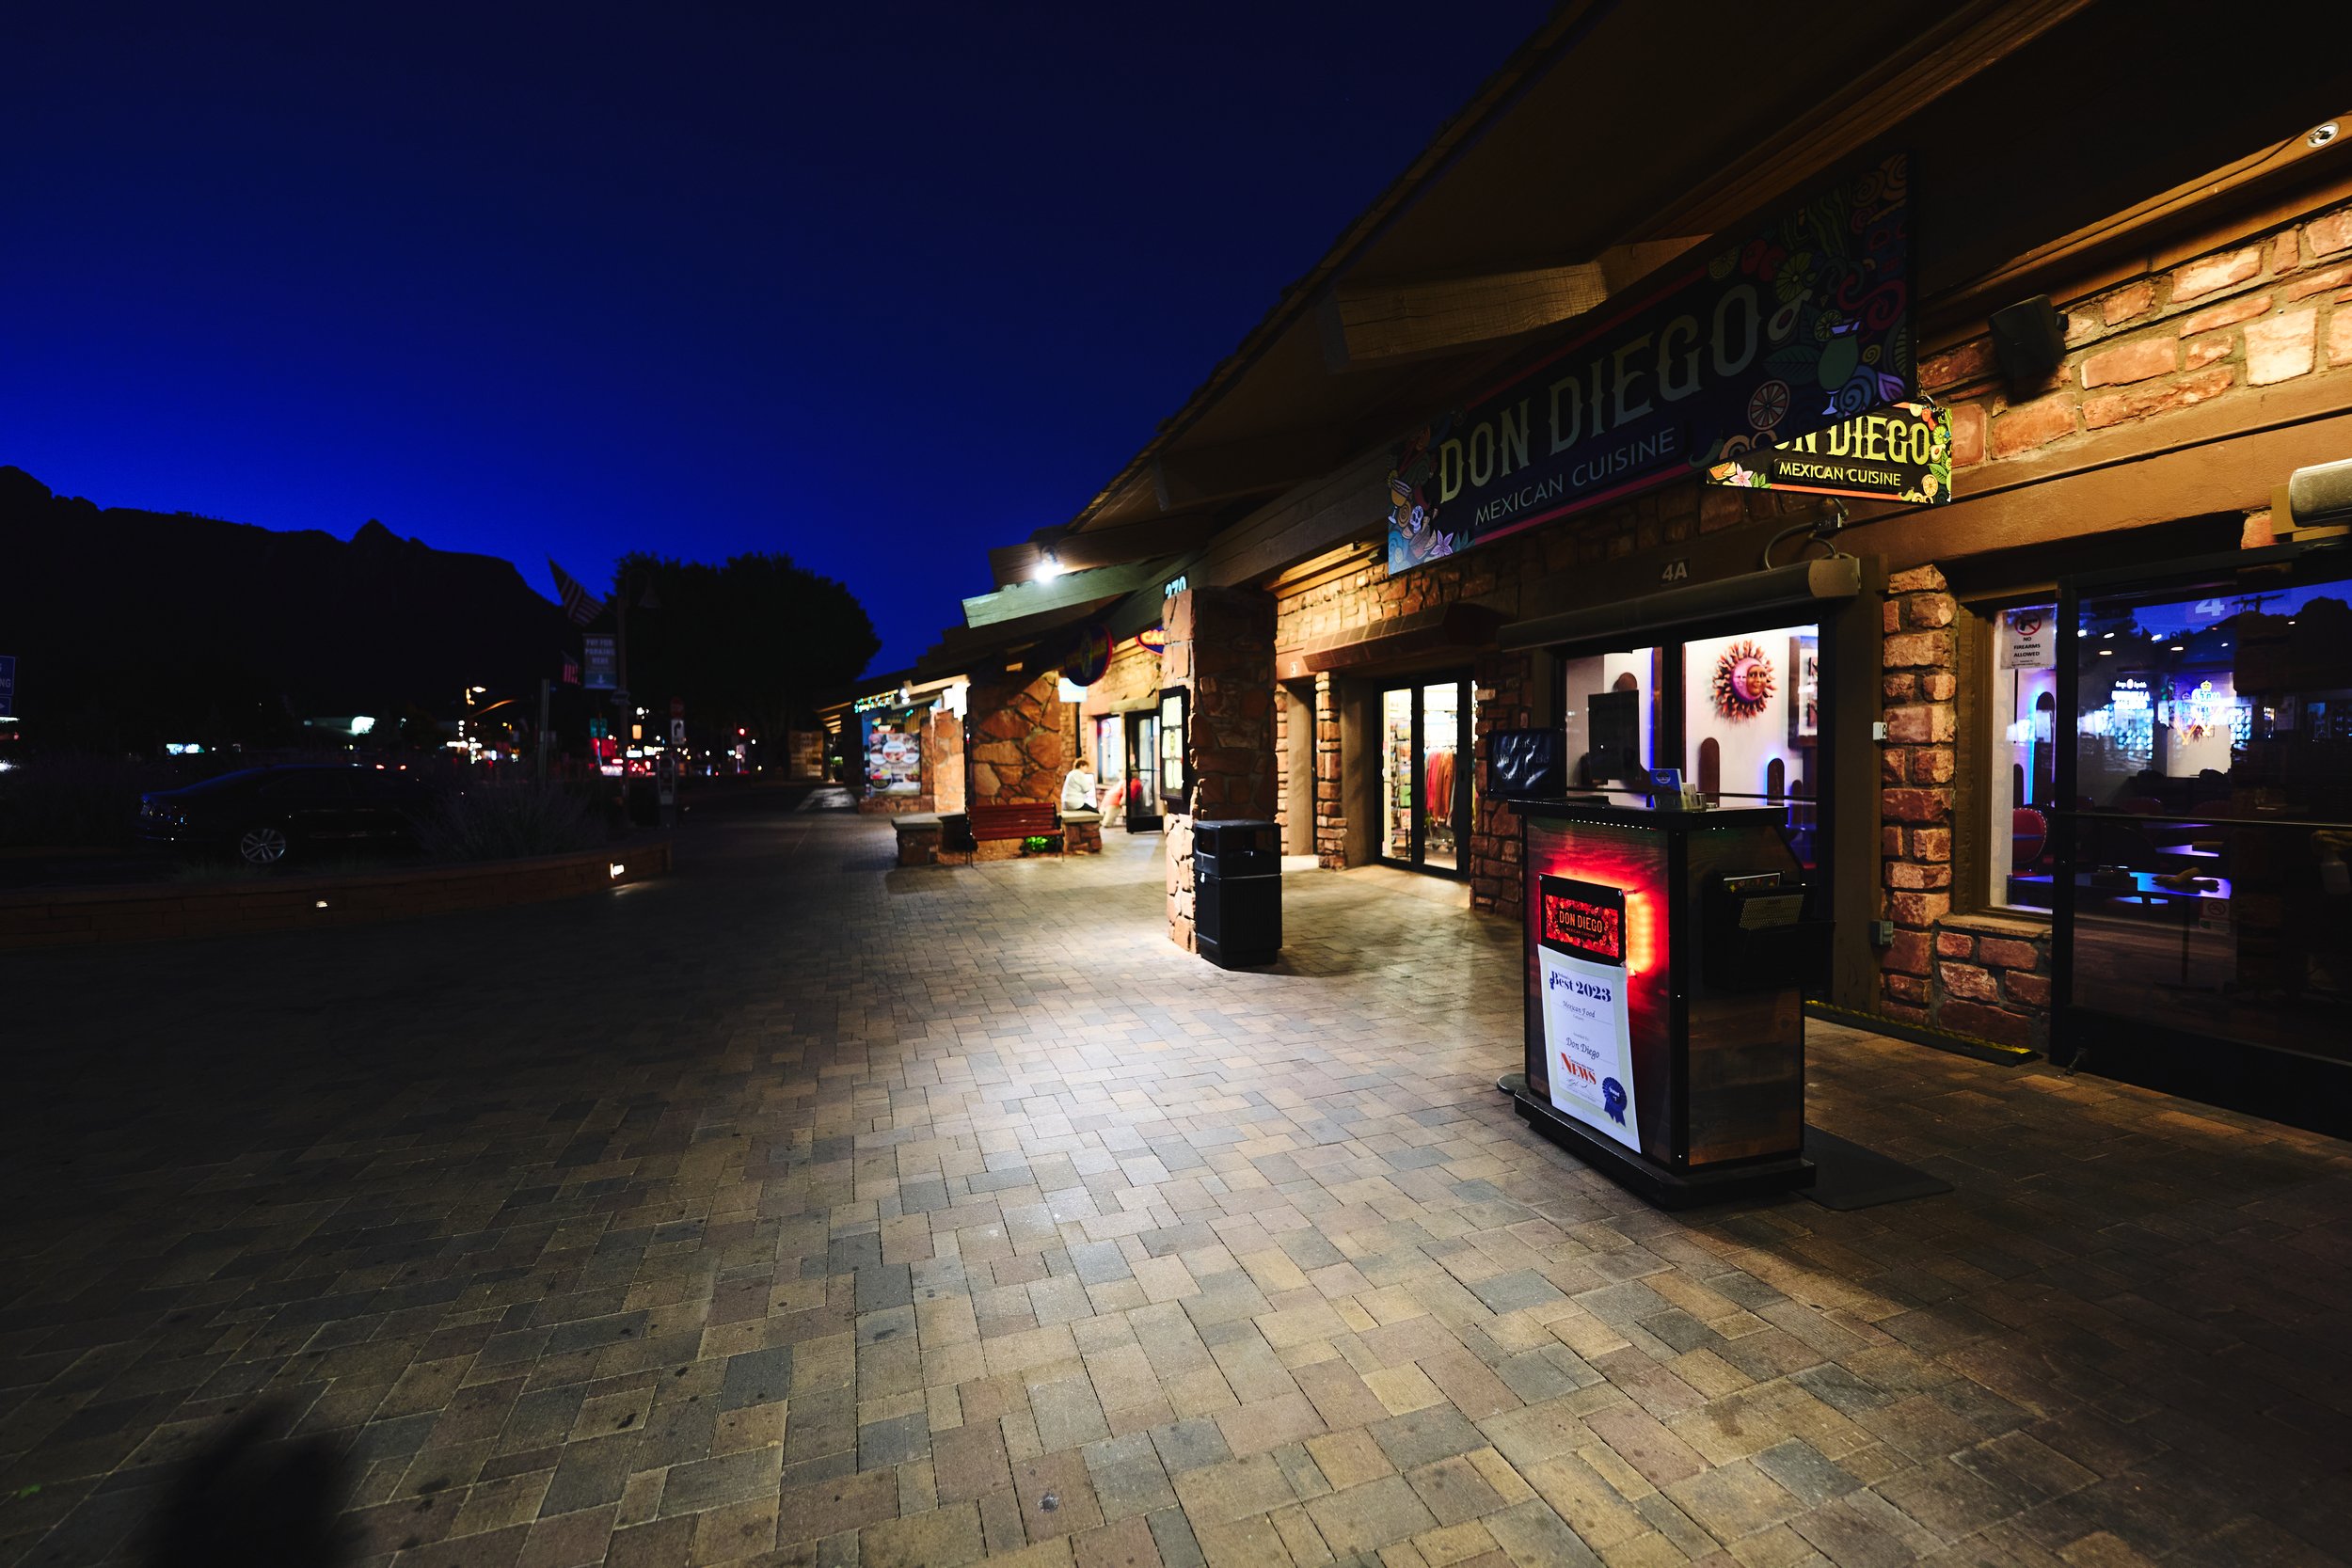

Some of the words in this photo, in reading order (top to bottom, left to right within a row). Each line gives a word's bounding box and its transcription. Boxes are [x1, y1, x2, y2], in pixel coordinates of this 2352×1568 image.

[1439, 398, 1531, 504] DON
[1549, 284, 1763, 456] DIEGO
[1827, 416, 1930, 466] DIEGO
[1475, 473, 1564, 526] MEXICAN
[1572, 426, 1676, 486] CUISINE
[1779, 461, 1844, 481] MEXICAN
[1847, 467, 1901, 486] CUISINE
[1661, 562, 1688, 581] 4A
[2195, 597, 2226, 617] 4
[1559, 911, 1576, 927] DON
[1577, 914, 1602, 934] DIEGO
[1551, 971, 1575, 992] Best
[1575, 981, 1612, 1003] 2023
[1581, 1007, 1596, 1018] Food
[1565, 1037, 1580, 1051] Don
[1580, 1043, 1600, 1060] Diego
[1559, 1052, 1597, 1085] NEWS
